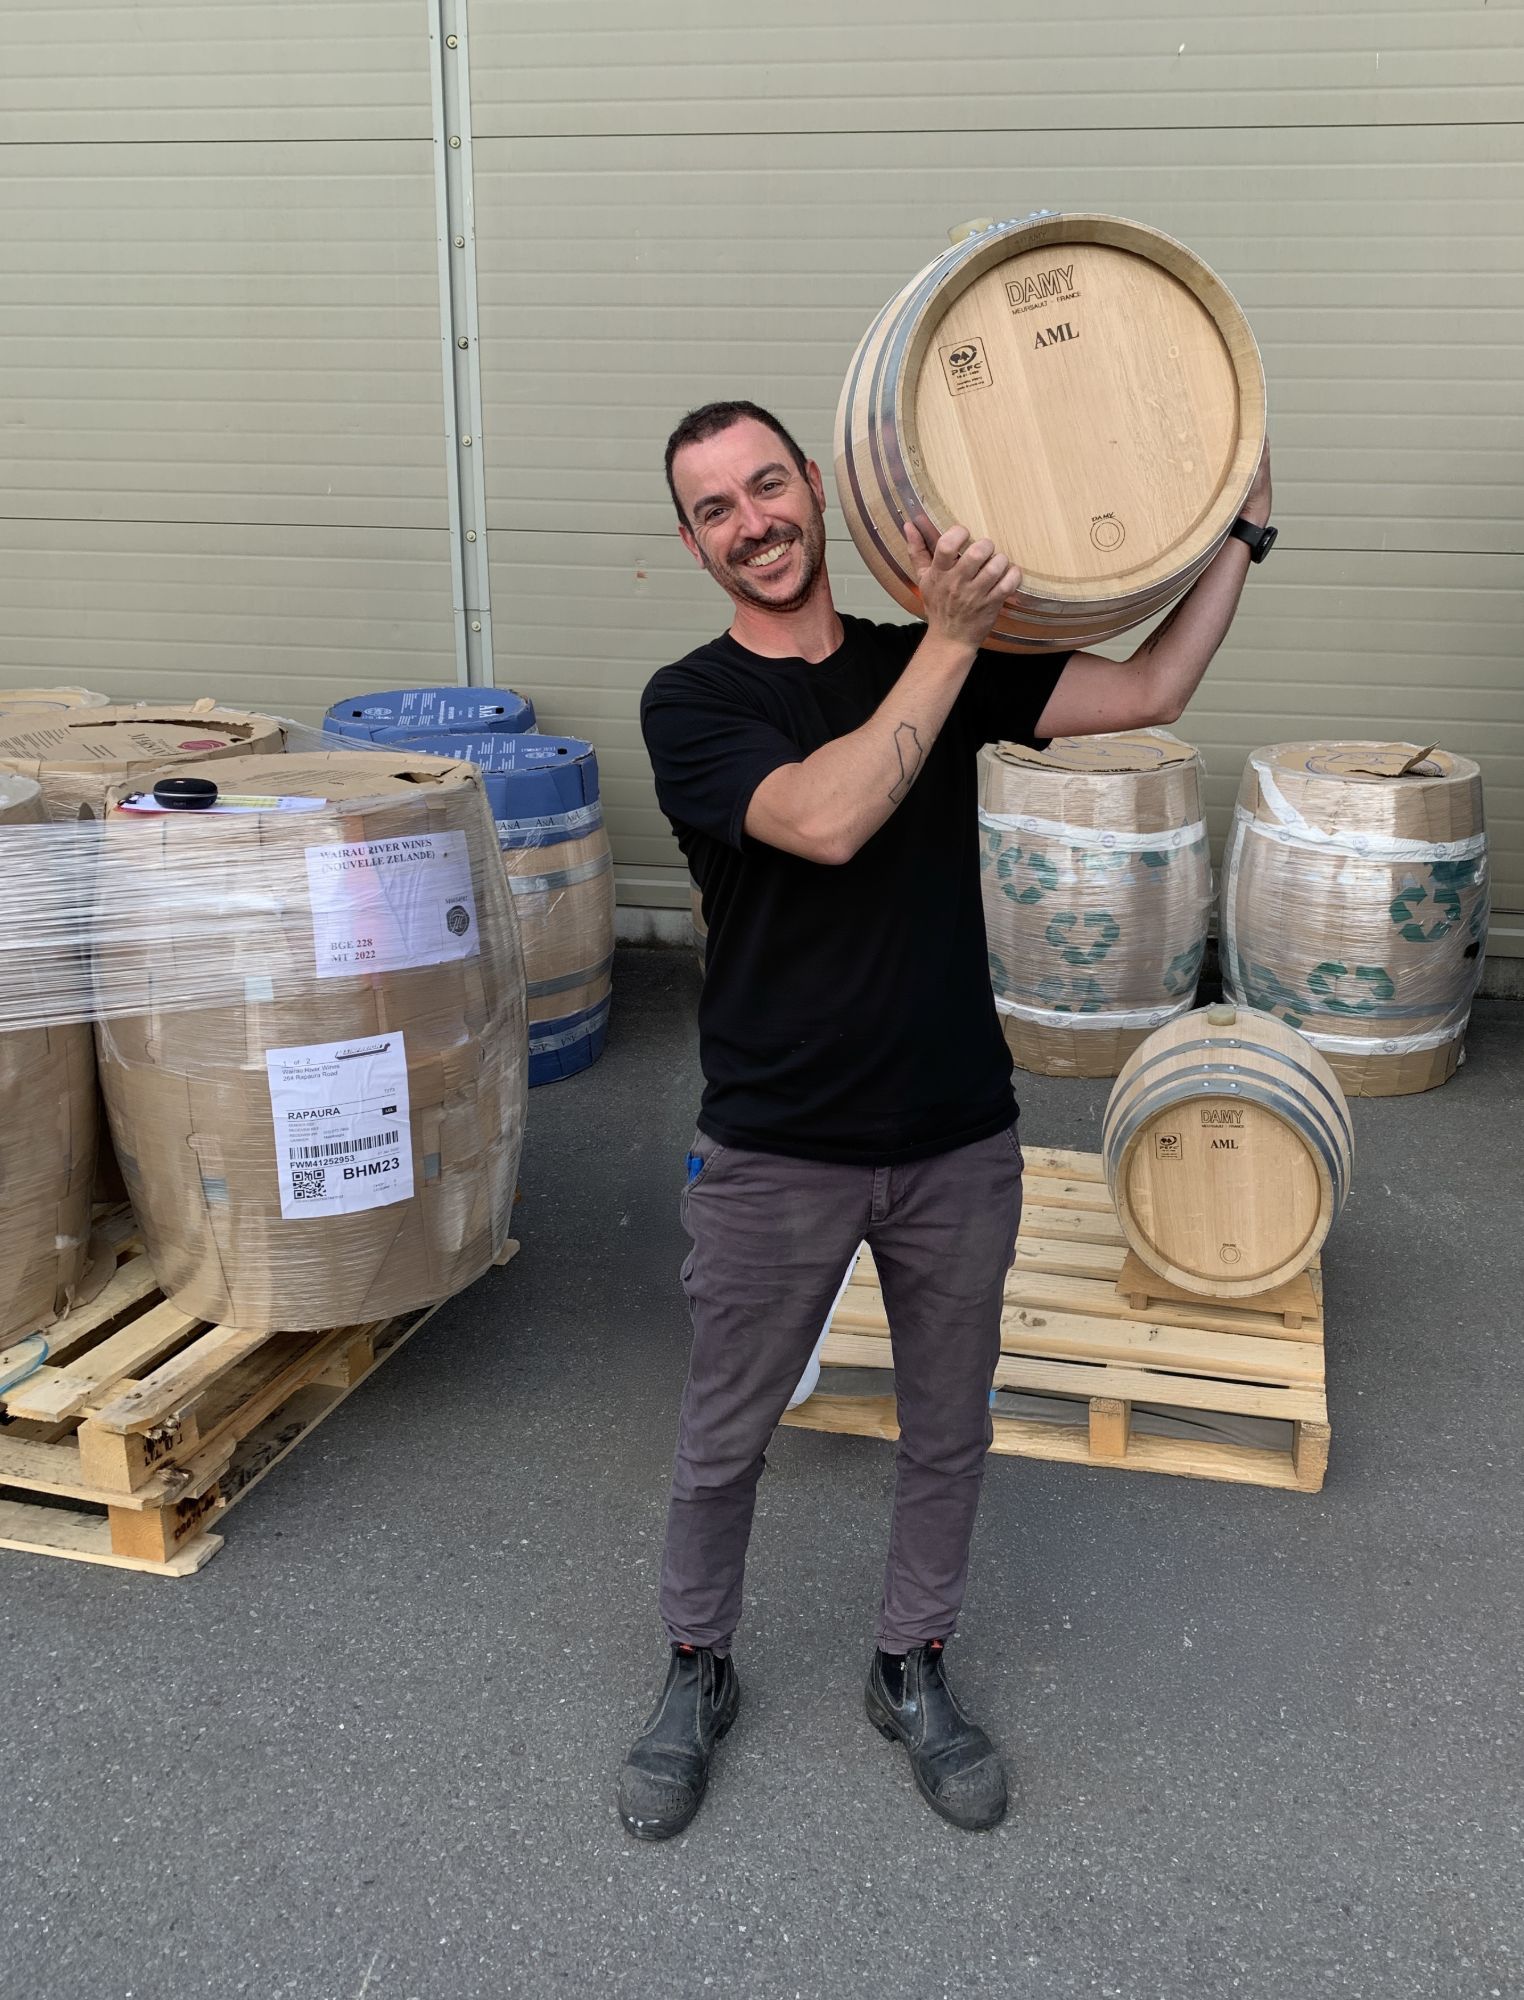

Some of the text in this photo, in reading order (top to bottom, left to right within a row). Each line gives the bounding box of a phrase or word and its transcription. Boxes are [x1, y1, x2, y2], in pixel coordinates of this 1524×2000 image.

[1005, 264, 1074, 307] DAMY
[1011, 300, 1048, 315] MEURSAULT
[1056, 291, 1082, 303] FRANCE
[1034, 322, 1080, 350] AML
[951, 362, 982, 376] PEFC
[1091, 511, 1114, 522] DAMY
[320, 839, 433, 858] WAIRAU RIVER WINES
[386, 850, 435, 865] ZELANDE)
[331, 938, 373, 951] BGE 228
[354, 950, 376, 961] 2022
[306, 1057, 311, 1065] 2
[295, 1073, 321, 1081] Rapaura
[322, 1070, 338, 1078] Road
[288, 1107, 341, 1121] RAPAURA
[1200, 1109, 1244, 1124] DAMY
[1210, 1139, 1239, 1149] AML
[290, 1154, 356, 1169] FWM41252953
[343, 1157, 400, 1181] BHM23
